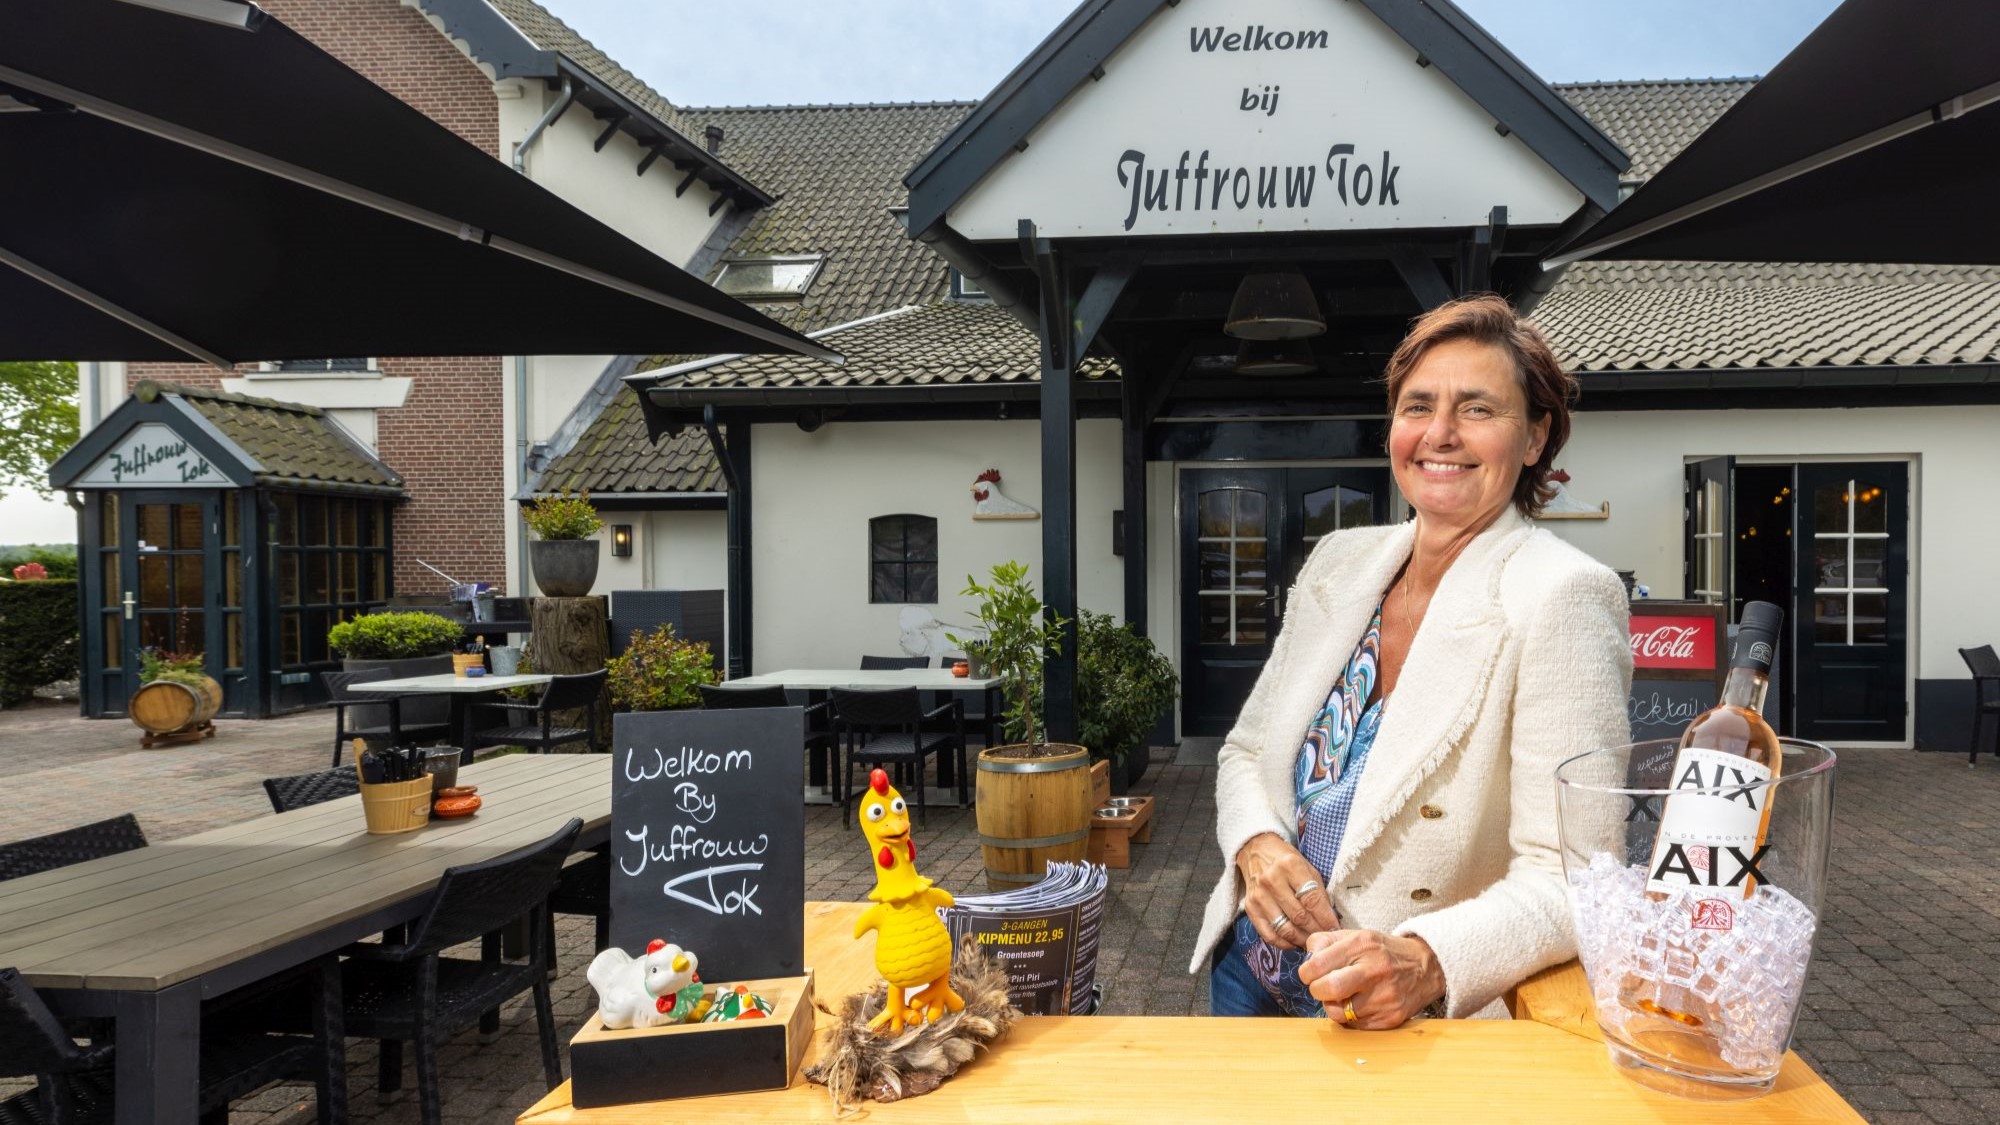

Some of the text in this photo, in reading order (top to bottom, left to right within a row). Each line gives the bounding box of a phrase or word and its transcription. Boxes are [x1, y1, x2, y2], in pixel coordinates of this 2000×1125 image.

[1190, 25, 1329, 53] Welkom
[1239, 85, 1280, 117] bij
[1116, 143, 1401, 232] Juffrouw Tok
[108, 440, 188, 483] Juffrouw
[177, 456, 210, 483] Tok
[625, 746, 752, 782] Welkom
[673, 782, 717, 823] By
[1676, 760, 1765, 811] AIX
[620, 824, 769, 877] Juffrouw
[1651, 843, 1773, 887] AIX
[663, 862, 763, 916] Tok
[977, 932, 1032, 945] KIPMENU
[1034, 928, 1064, 944] 22,95
[1001, 919, 1049, 931] 3-GANGEN
[997, 949, 1045, 960] Groentesoep
[1011, 974, 1025, 983] Piri
[1026, 973, 1041, 982] Piri
